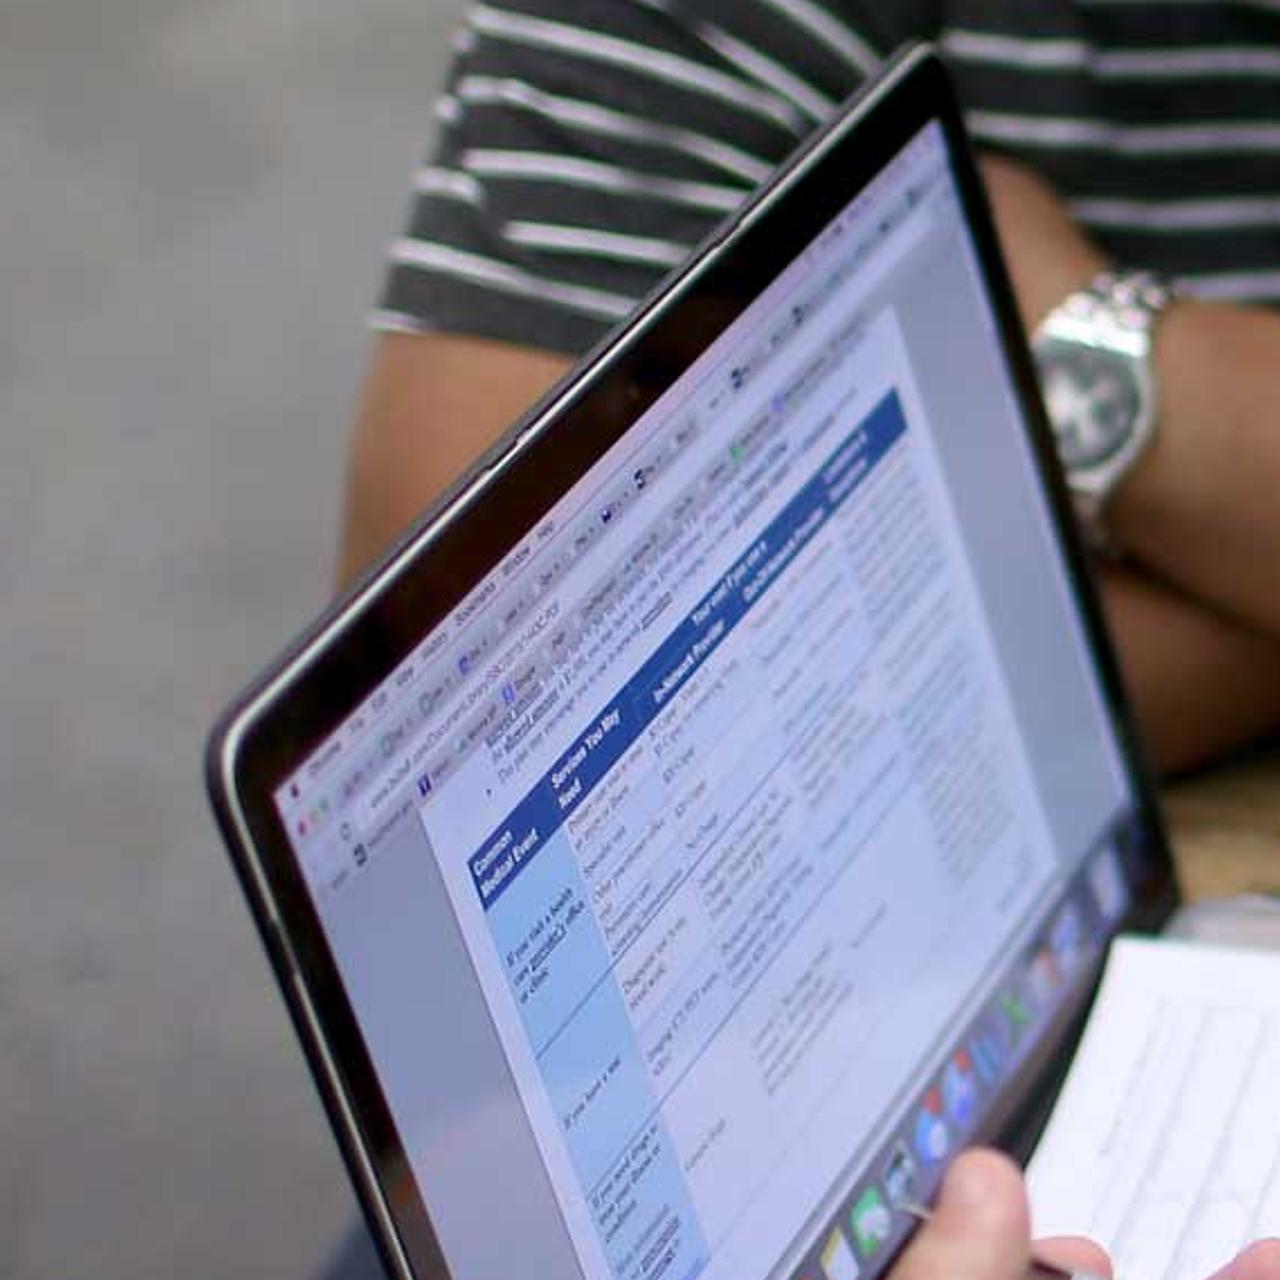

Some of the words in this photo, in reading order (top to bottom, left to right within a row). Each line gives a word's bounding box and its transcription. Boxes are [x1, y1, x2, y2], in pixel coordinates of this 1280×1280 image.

[472, 826, 512, 878] Common
[550, 742, 587, 791] Services
[480, 852, 515, 900] Medical
[512, 826, 538, 864] Event
[558, 776, 582, 812] Need
